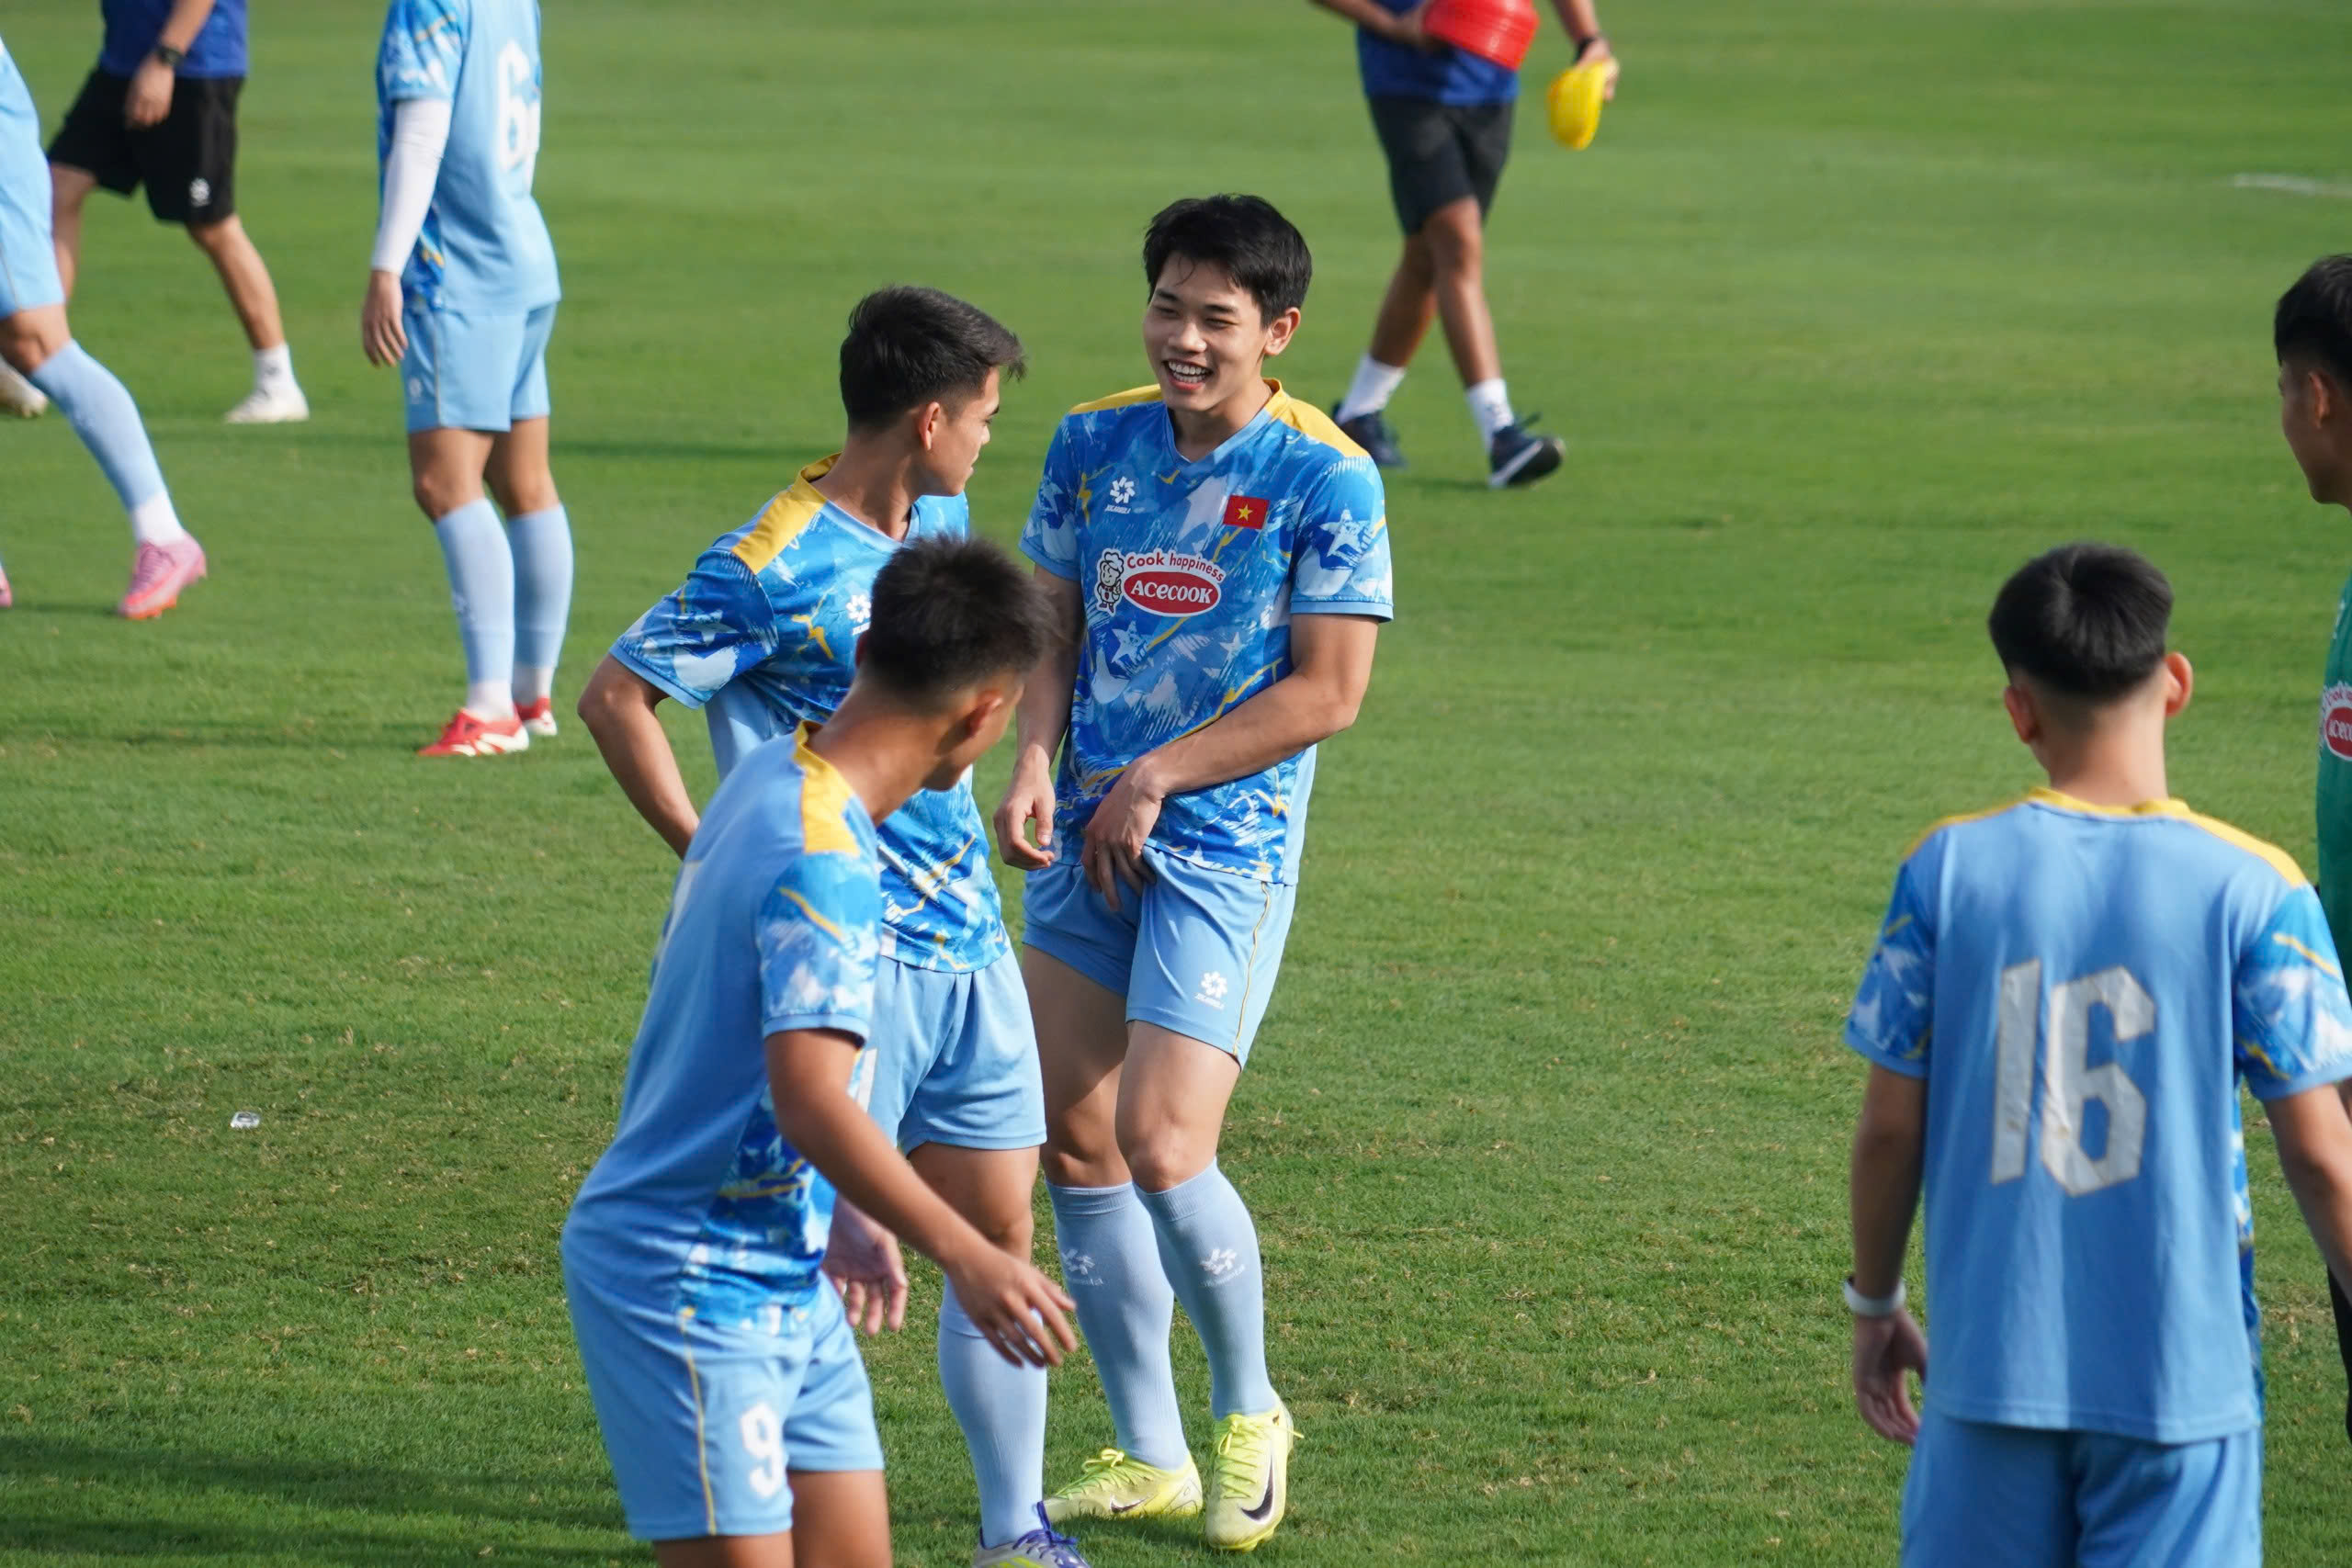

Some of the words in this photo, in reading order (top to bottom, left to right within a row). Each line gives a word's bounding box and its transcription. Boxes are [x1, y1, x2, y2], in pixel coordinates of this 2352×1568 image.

[1126, 551, 1165, 570] Cook
[1170, 552, 1225, 581] happiness
[1990, 958, 2156, 1197] 16
[738, 1402, 786, 1499] 9
